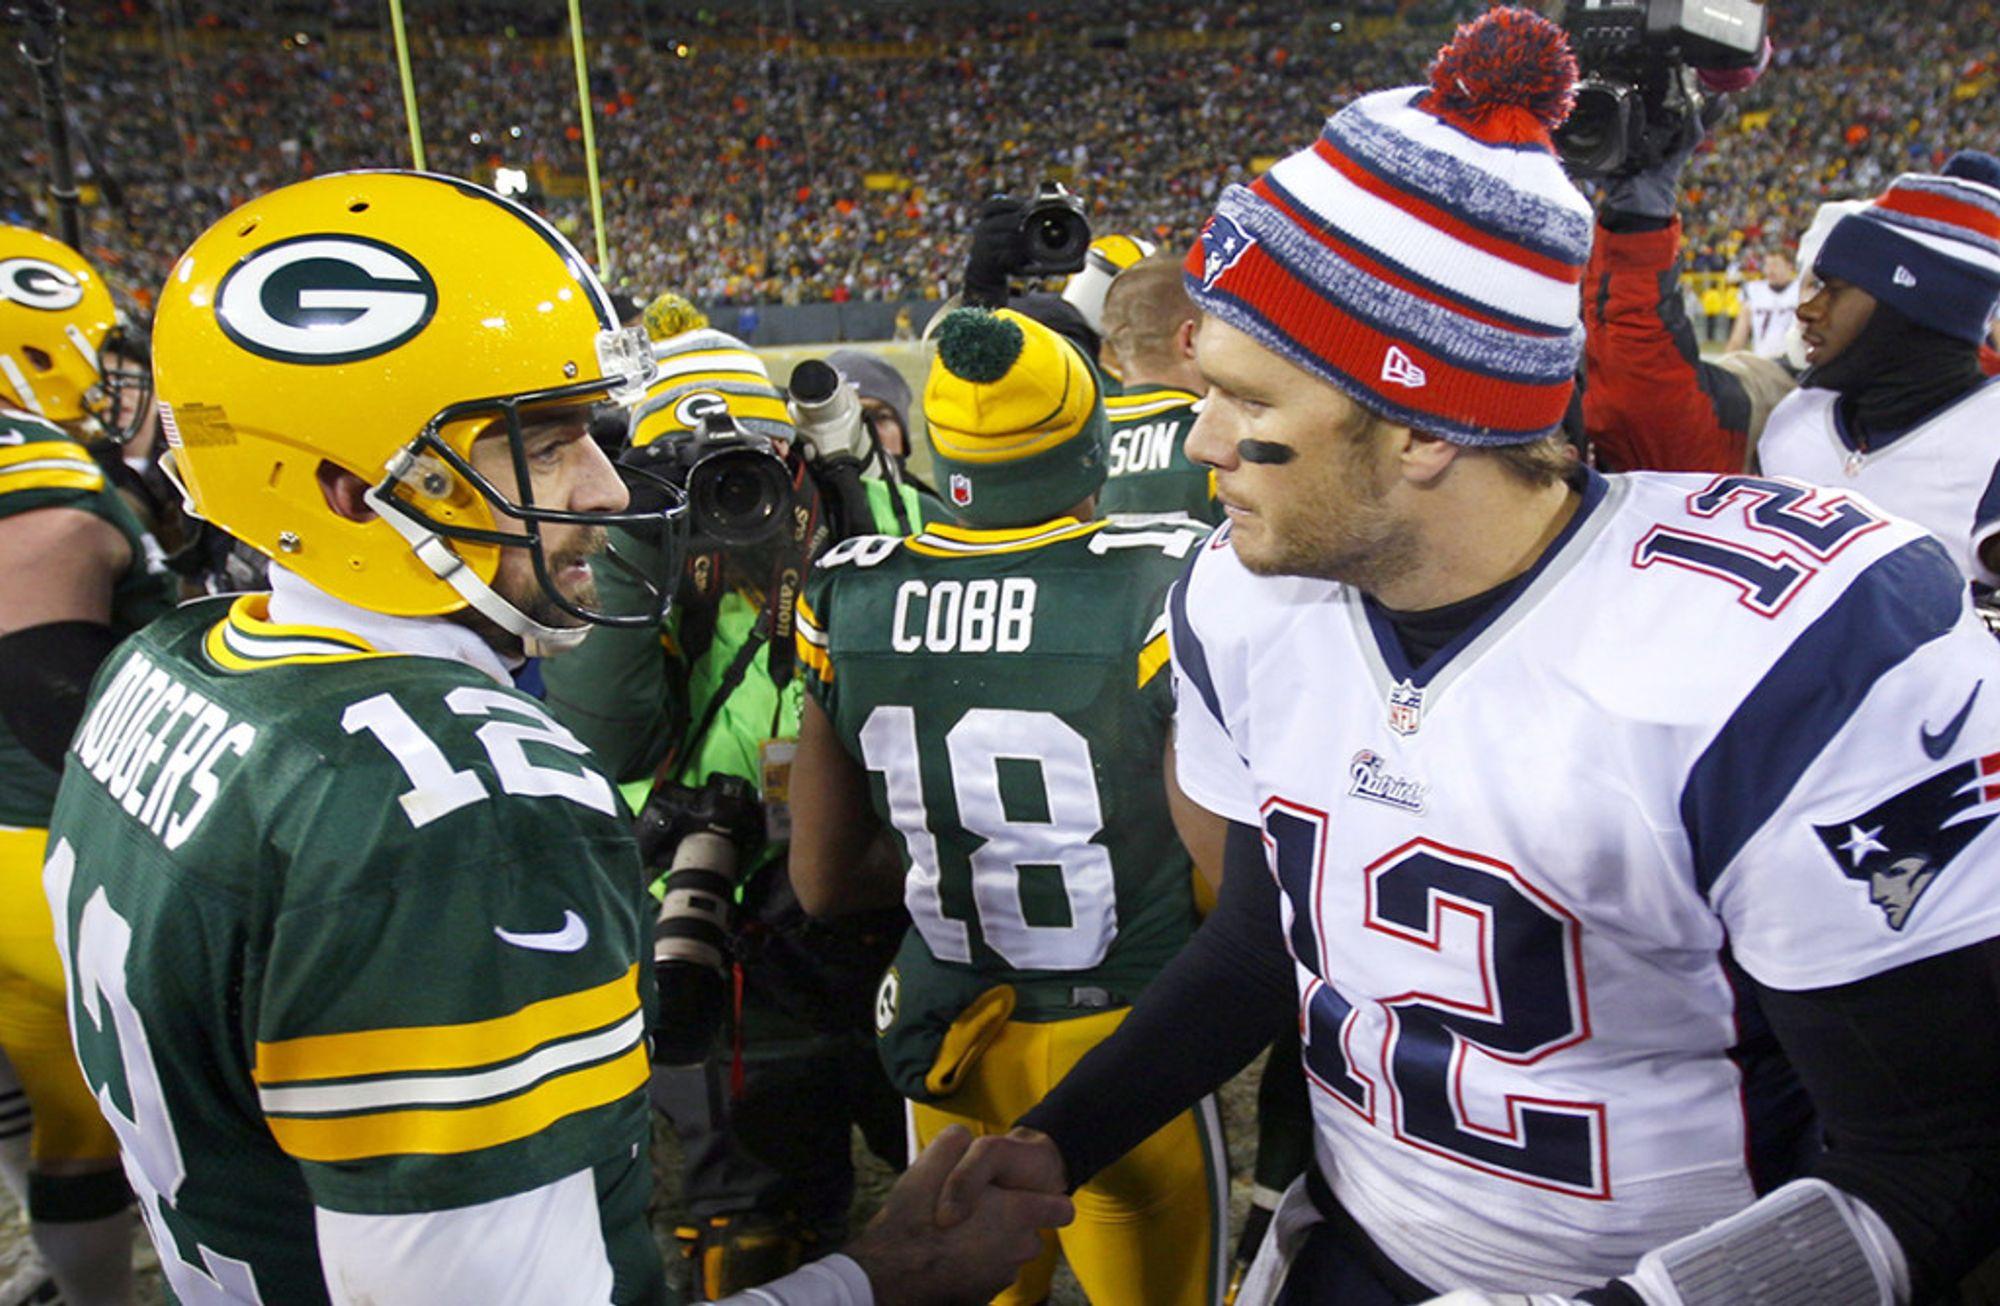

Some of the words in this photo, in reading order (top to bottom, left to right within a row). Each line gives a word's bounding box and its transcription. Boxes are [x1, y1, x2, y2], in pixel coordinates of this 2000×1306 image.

[0, 258, 83, 310] G
[222, 239, 428, 355] G
[677, 393, 728, 426] G
[1108, 421, 1179, 478] SON
[1631, 473, 1889, 619] 12
[777, 568, 799, 637] Canon
[892, 577, 1037, 653] COBB
[341, 686, 617, 828] 12
[859, 706, 1118, 971] 18
[1260, 796, 1611, 1200] 12
